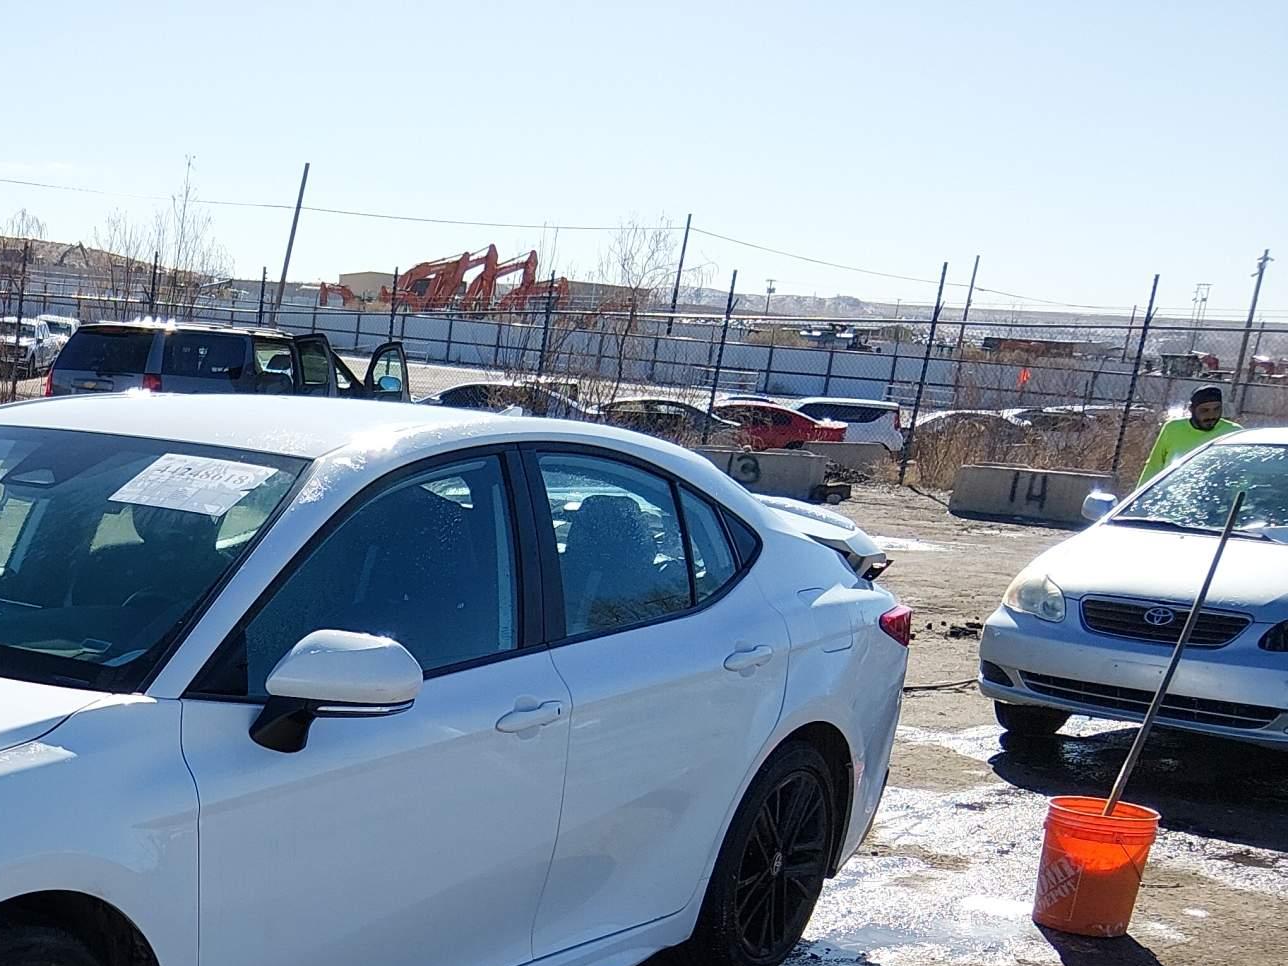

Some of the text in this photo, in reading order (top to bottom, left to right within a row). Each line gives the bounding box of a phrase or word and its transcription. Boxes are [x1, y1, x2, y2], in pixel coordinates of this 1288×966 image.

[156, 465, 249, 485] 44248618
[727, 452, 761, 484] 13
[1009, 470, 1048, 511] 14
